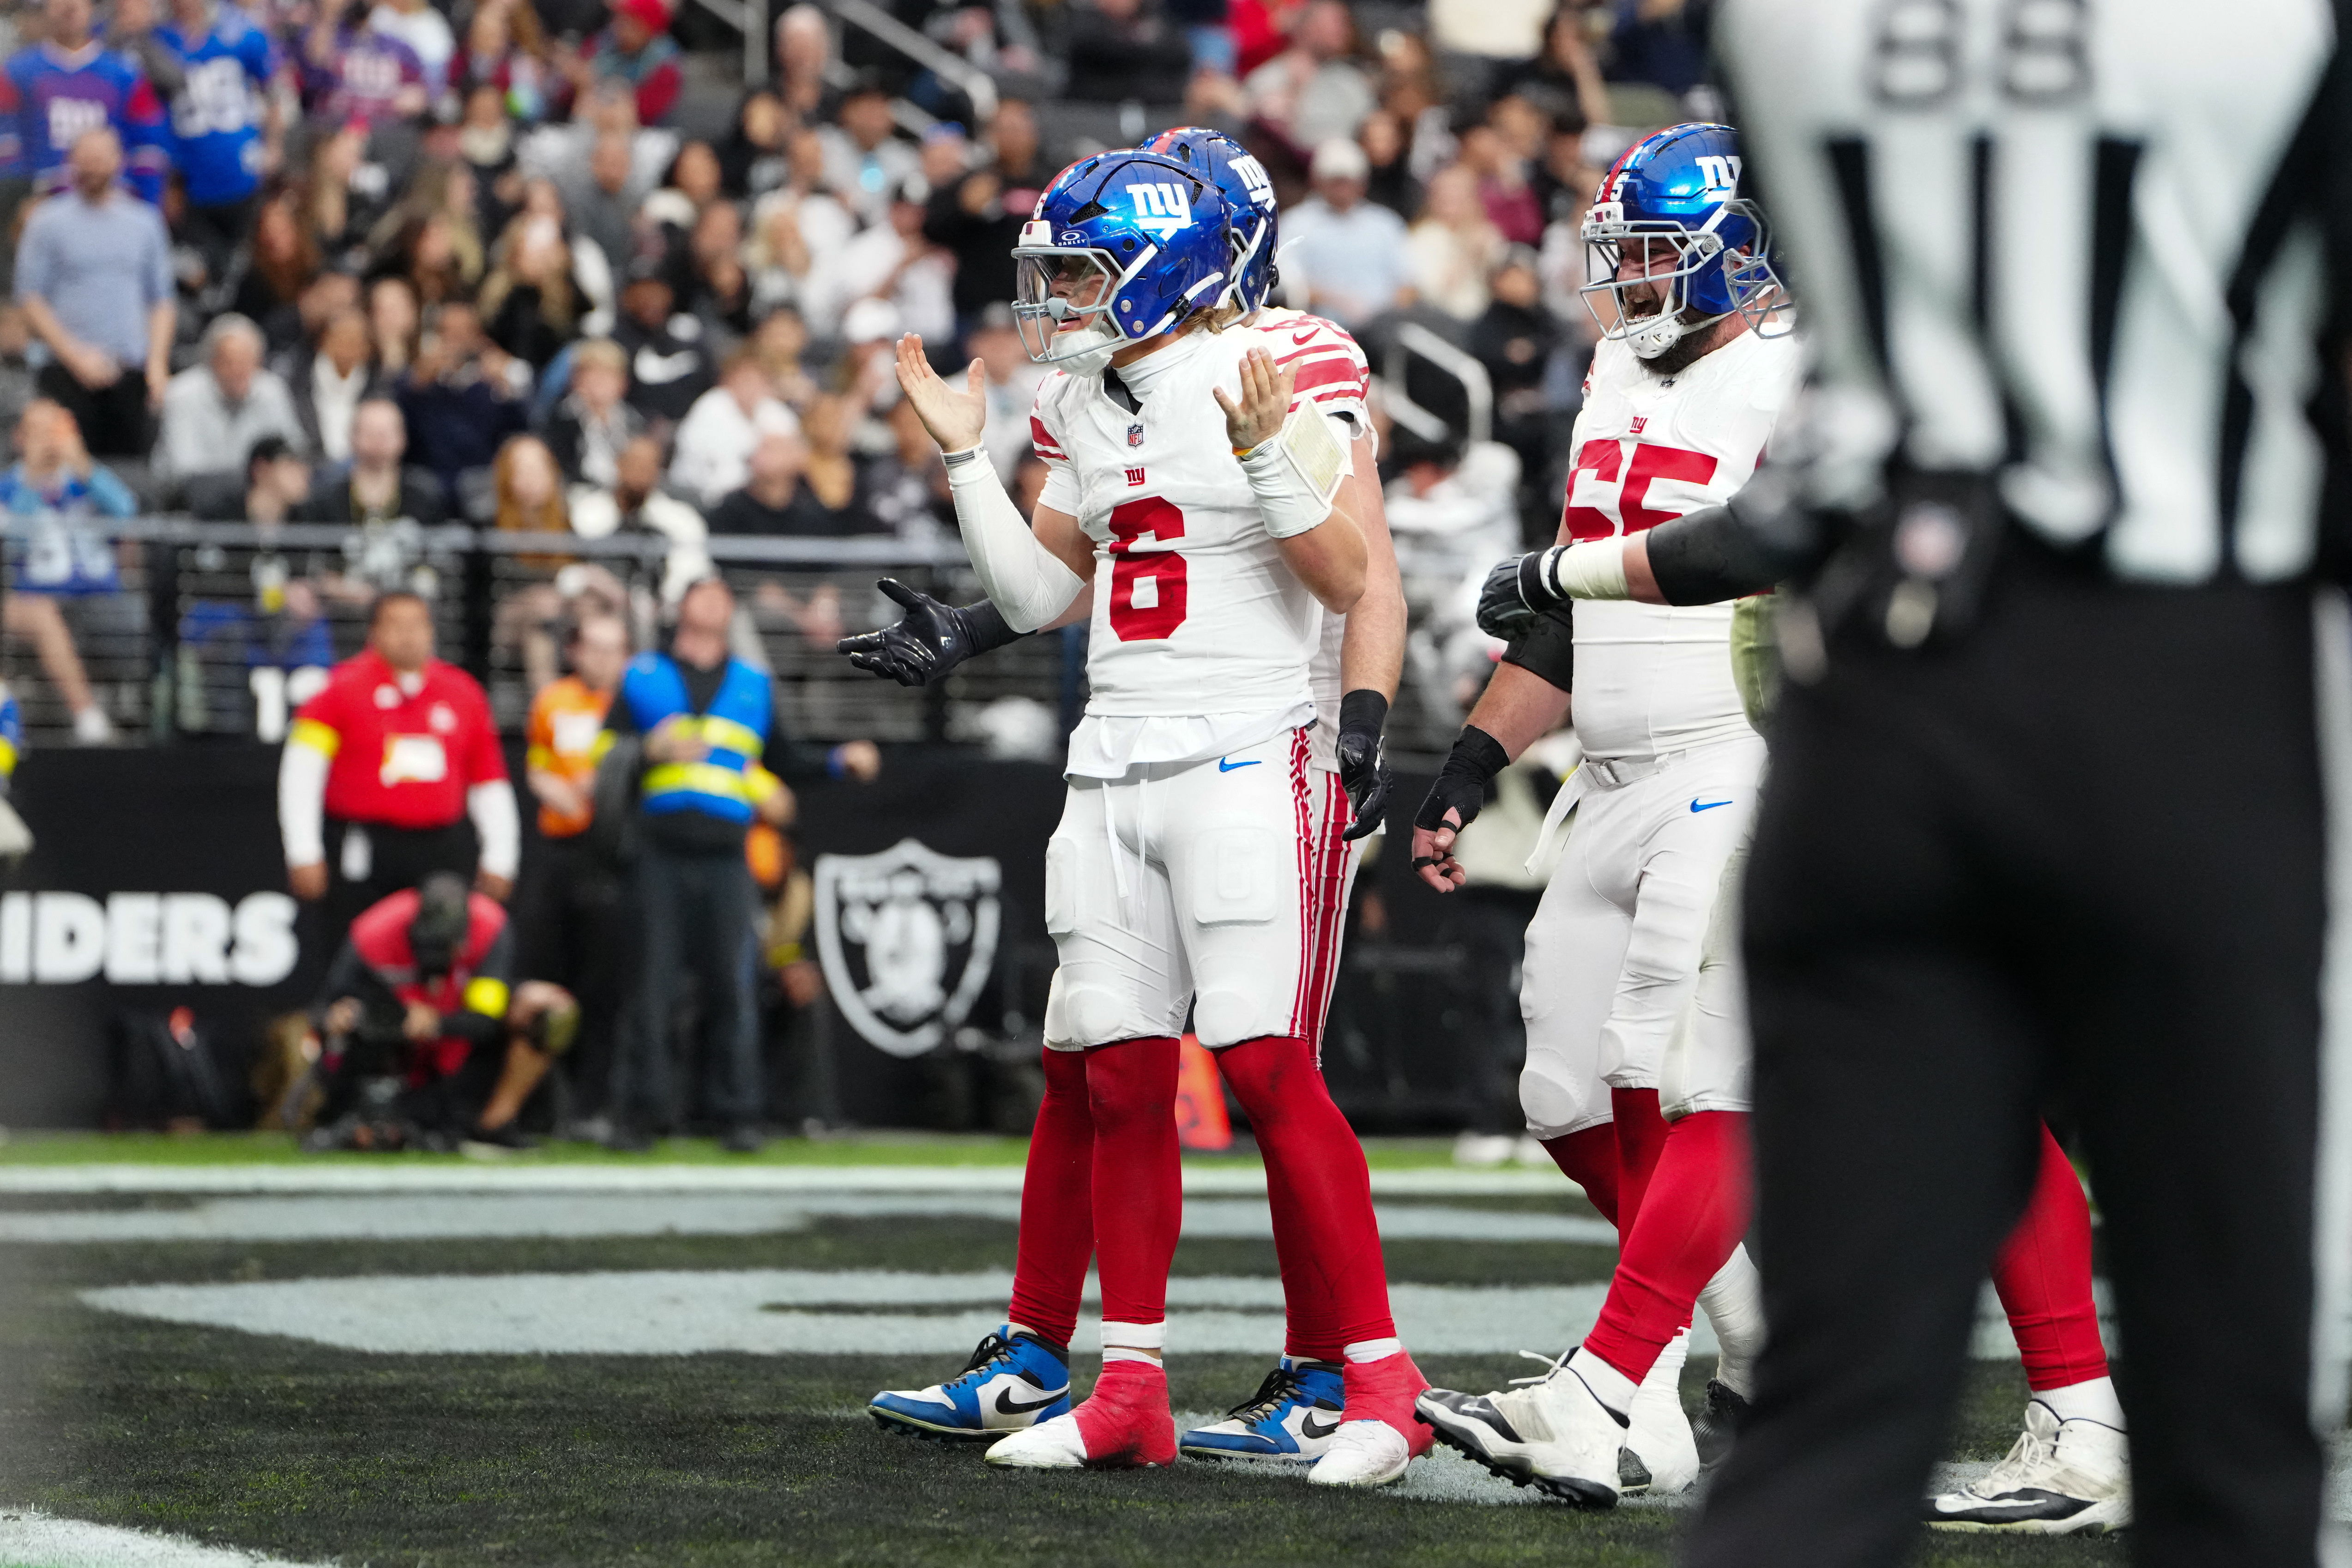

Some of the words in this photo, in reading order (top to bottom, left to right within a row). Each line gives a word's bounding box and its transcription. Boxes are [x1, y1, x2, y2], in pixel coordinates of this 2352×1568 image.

[1863, 0, 2095, 113] 88
[1227, 155, 1274, 203] ny
[1595, 174, 1630, 202] 65
[1033, 192, 1048, 220] 6
[1125, 183, 1192, 229] ny
[1129, 433, 1141, 445] NFL
[1629, 416, 1648, 434] ny
[1124, 467, 1145, 487] ny
[1109, 495, 1187, 642] 6
